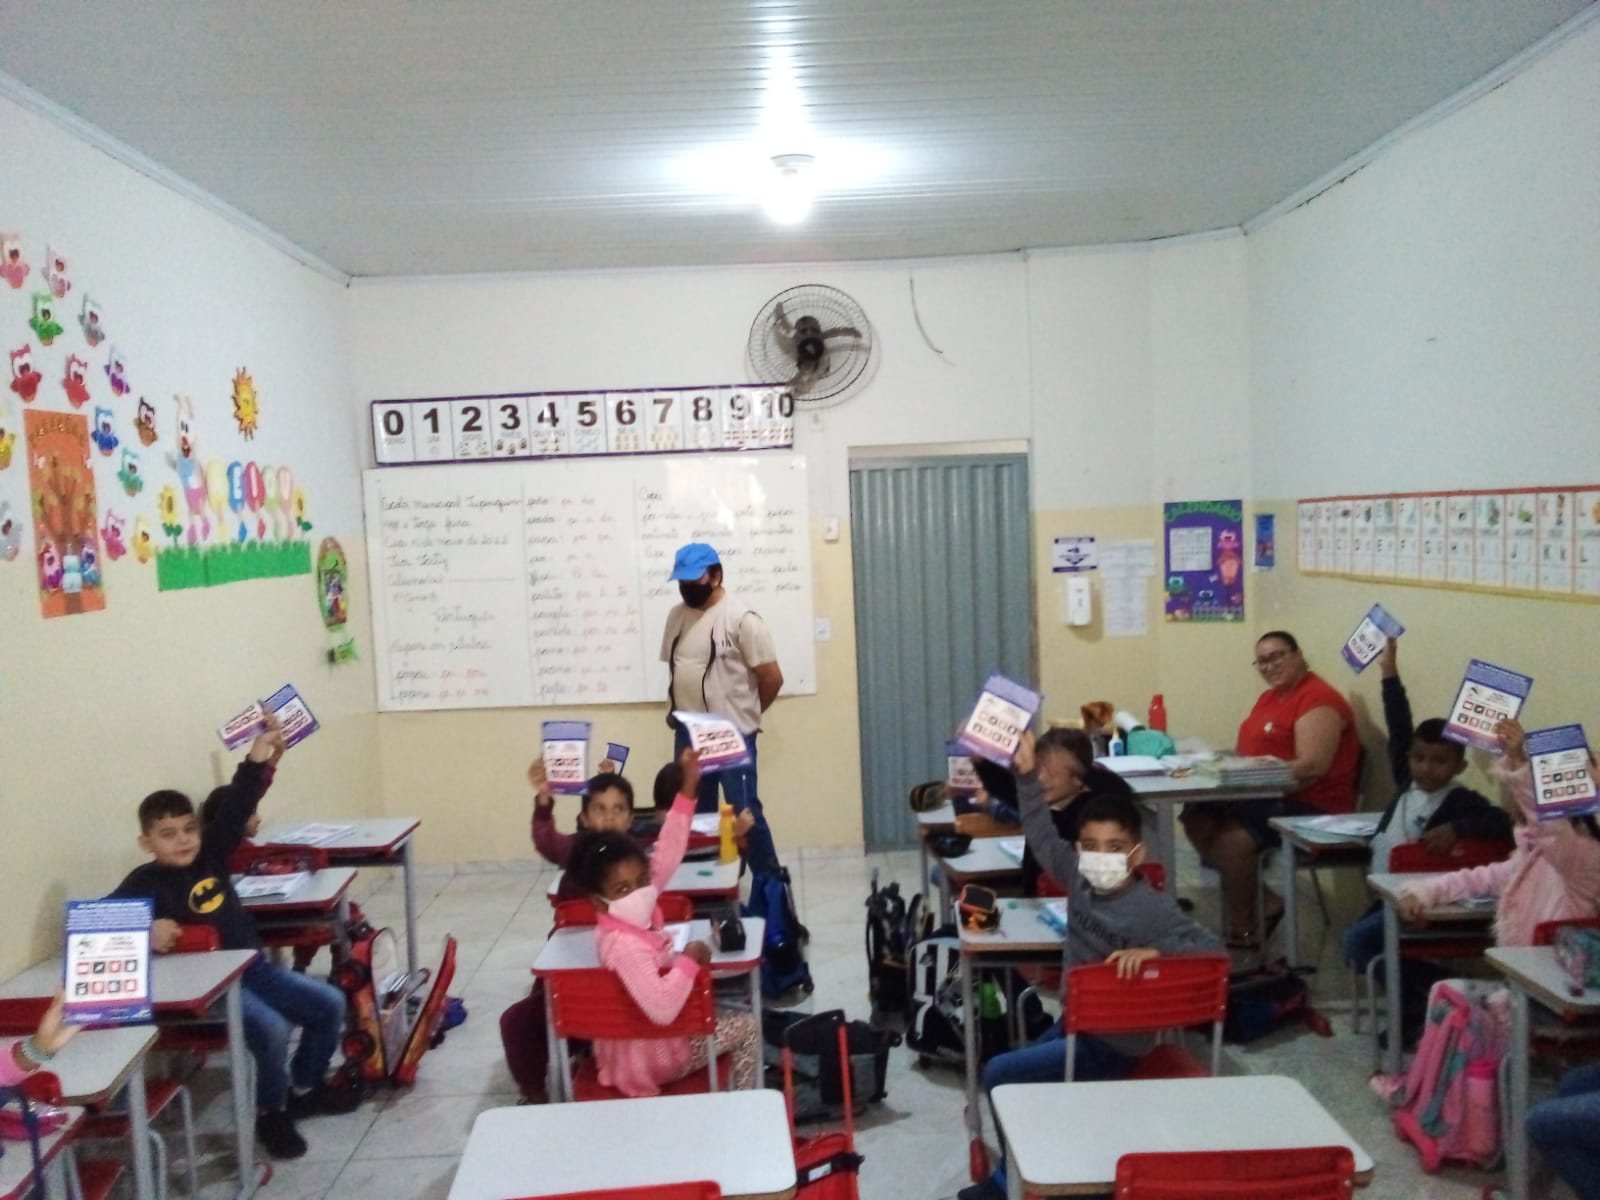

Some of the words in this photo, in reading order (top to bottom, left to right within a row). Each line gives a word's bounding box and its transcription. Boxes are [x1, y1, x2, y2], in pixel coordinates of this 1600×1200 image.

[383, 410, 404, 436] 0
[423, 408, 440, 434] 1
[461, 406, 483, 432] 2
[500, 404, 521, 430] 3
[537, 402, 559, 428] 4
[577, 401, 598, 427] 5
[615, 399, 637, 425] 6
[653, 398, 674, 424] 7
[693, 396, 713, 422] 8
[730, 394, 751, 420] 9
[761, 392, 795, 419] 10
